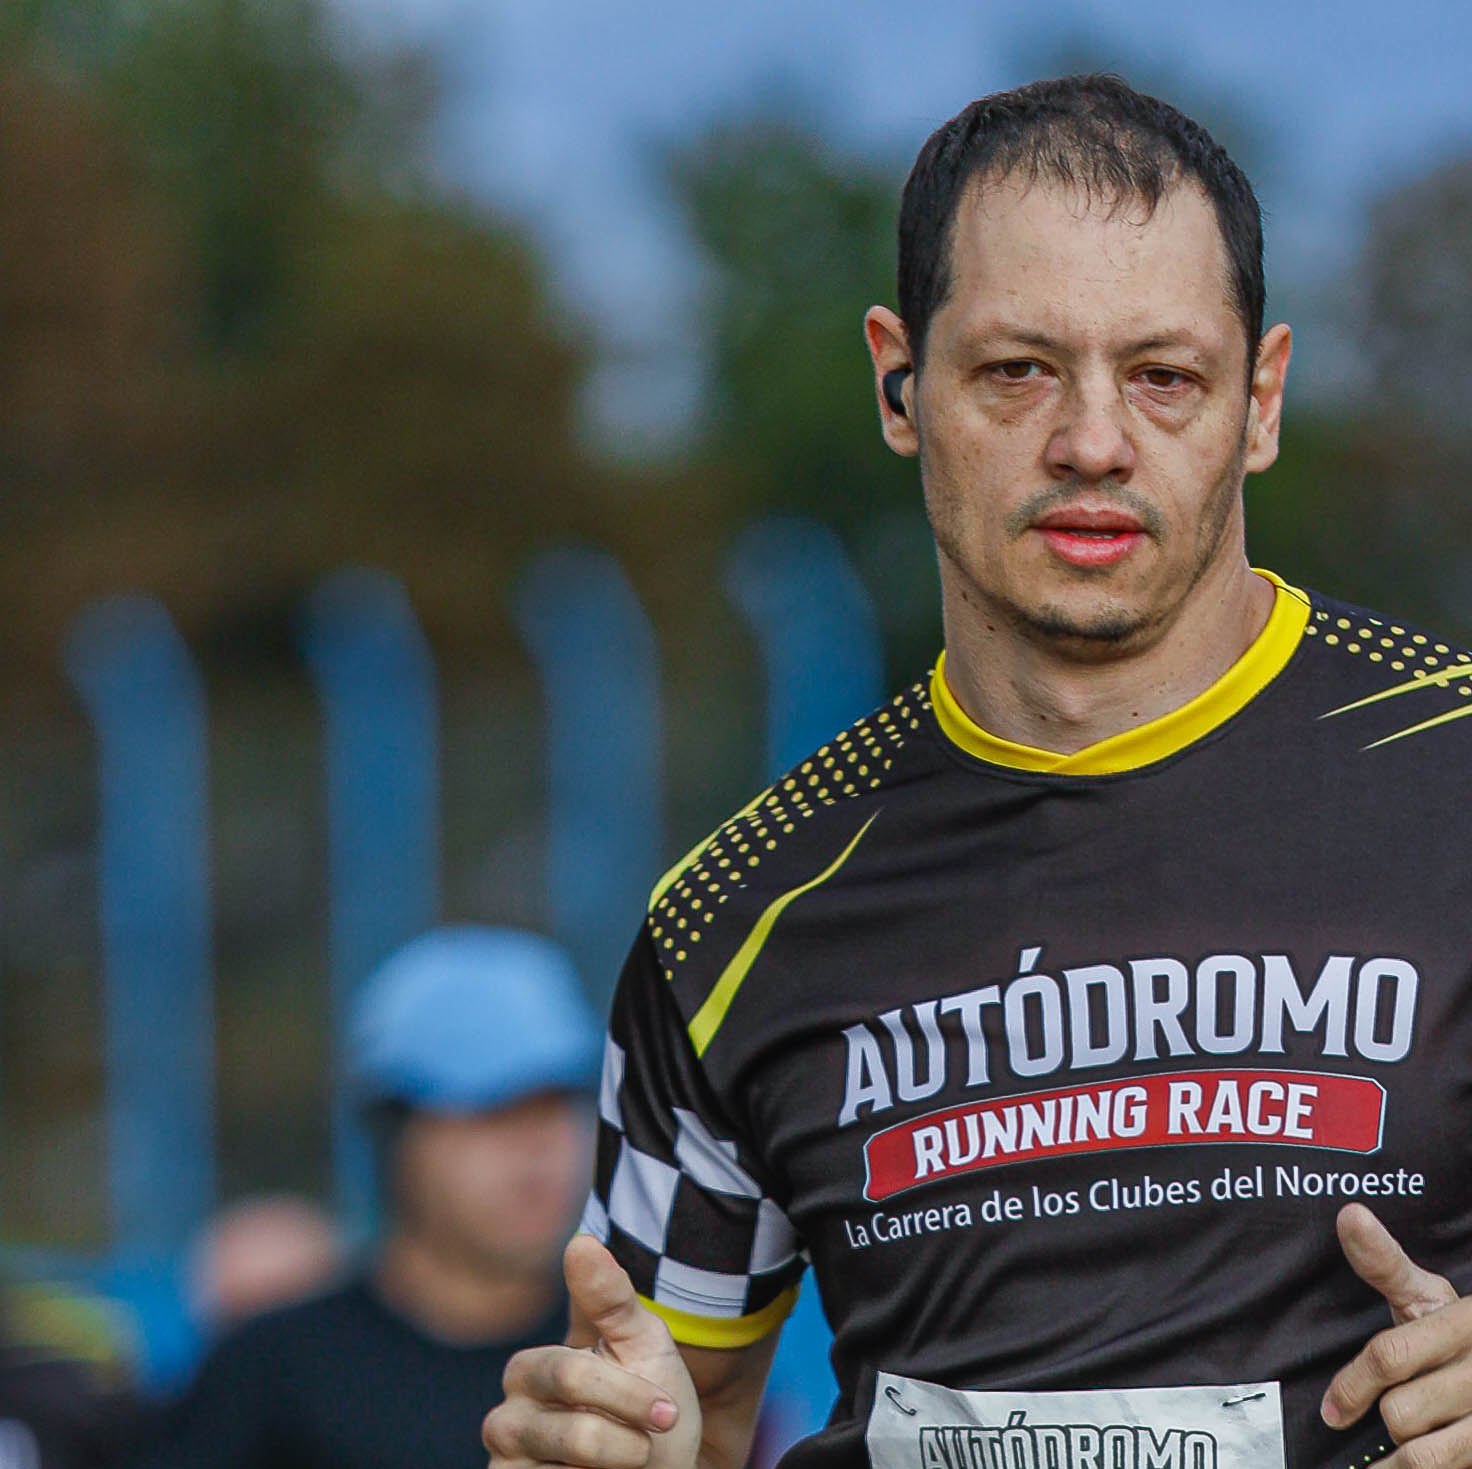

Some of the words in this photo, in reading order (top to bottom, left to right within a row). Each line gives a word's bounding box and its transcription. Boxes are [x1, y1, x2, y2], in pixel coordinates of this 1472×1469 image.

[839, 946, 1419, 1127] AUTÓDROMO
[912, 1085, 1149, 1180] RUNNING
[1168, 1080, 1319, 1139] RACE
[845, 1219, 871, 1249] La
[872, 1202, 973, 1242] Carrera
[981, 1189, 1024, 1222] de
[1032, 1185, 1080, 1218] los
[1089, 1177, 1201, 1212] Clubes
[1210, 1165, 1264, 1200] del
[1275, 1165, 1425, 1197] Noroeste
